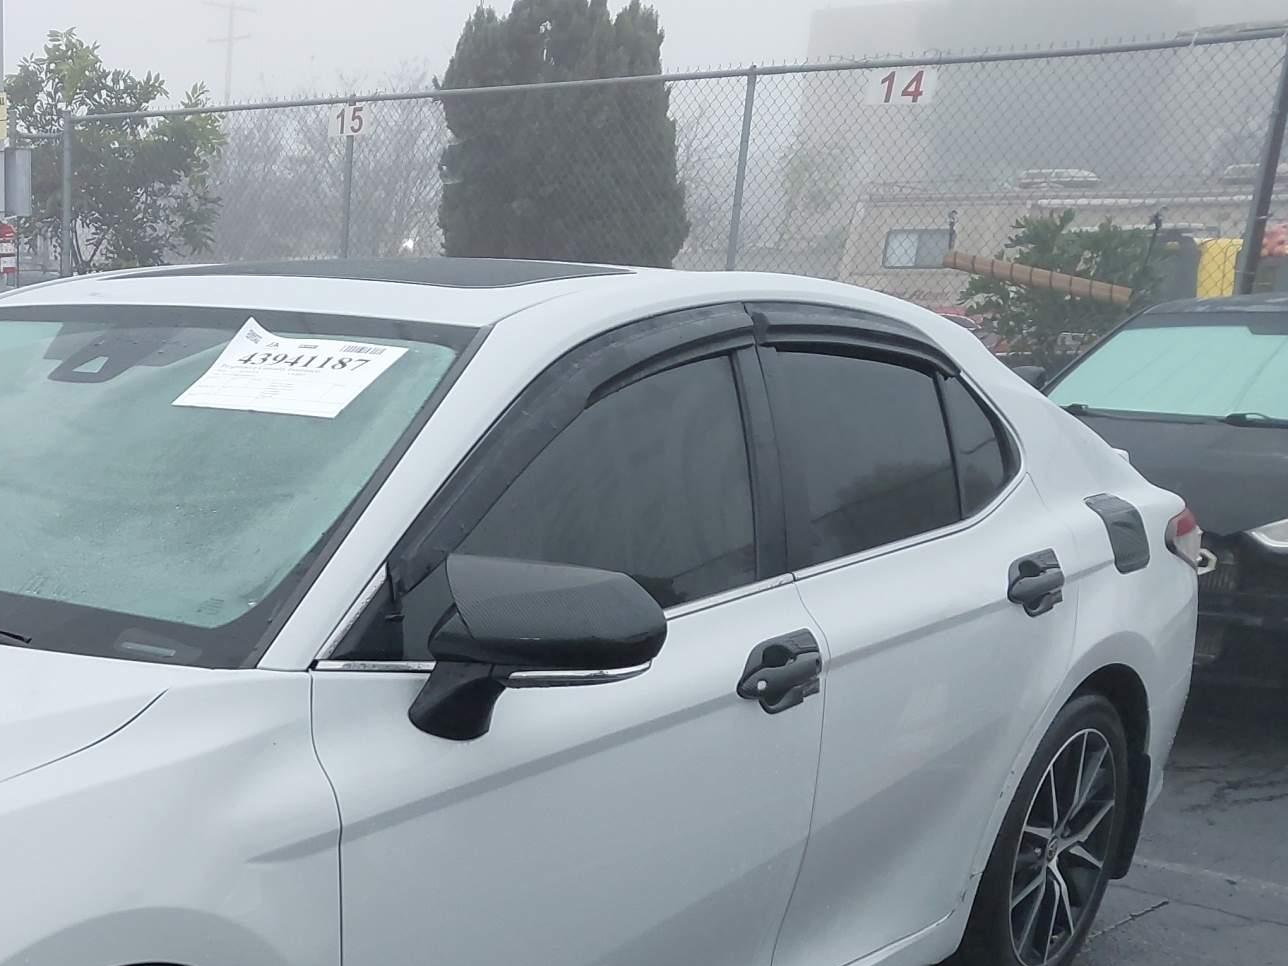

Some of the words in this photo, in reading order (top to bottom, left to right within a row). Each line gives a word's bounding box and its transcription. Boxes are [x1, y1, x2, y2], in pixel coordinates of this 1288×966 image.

[880, 70, 925, 103] 14
[336, 106, 363, 134] 15
[238, 351, 373, 372] 43941187
